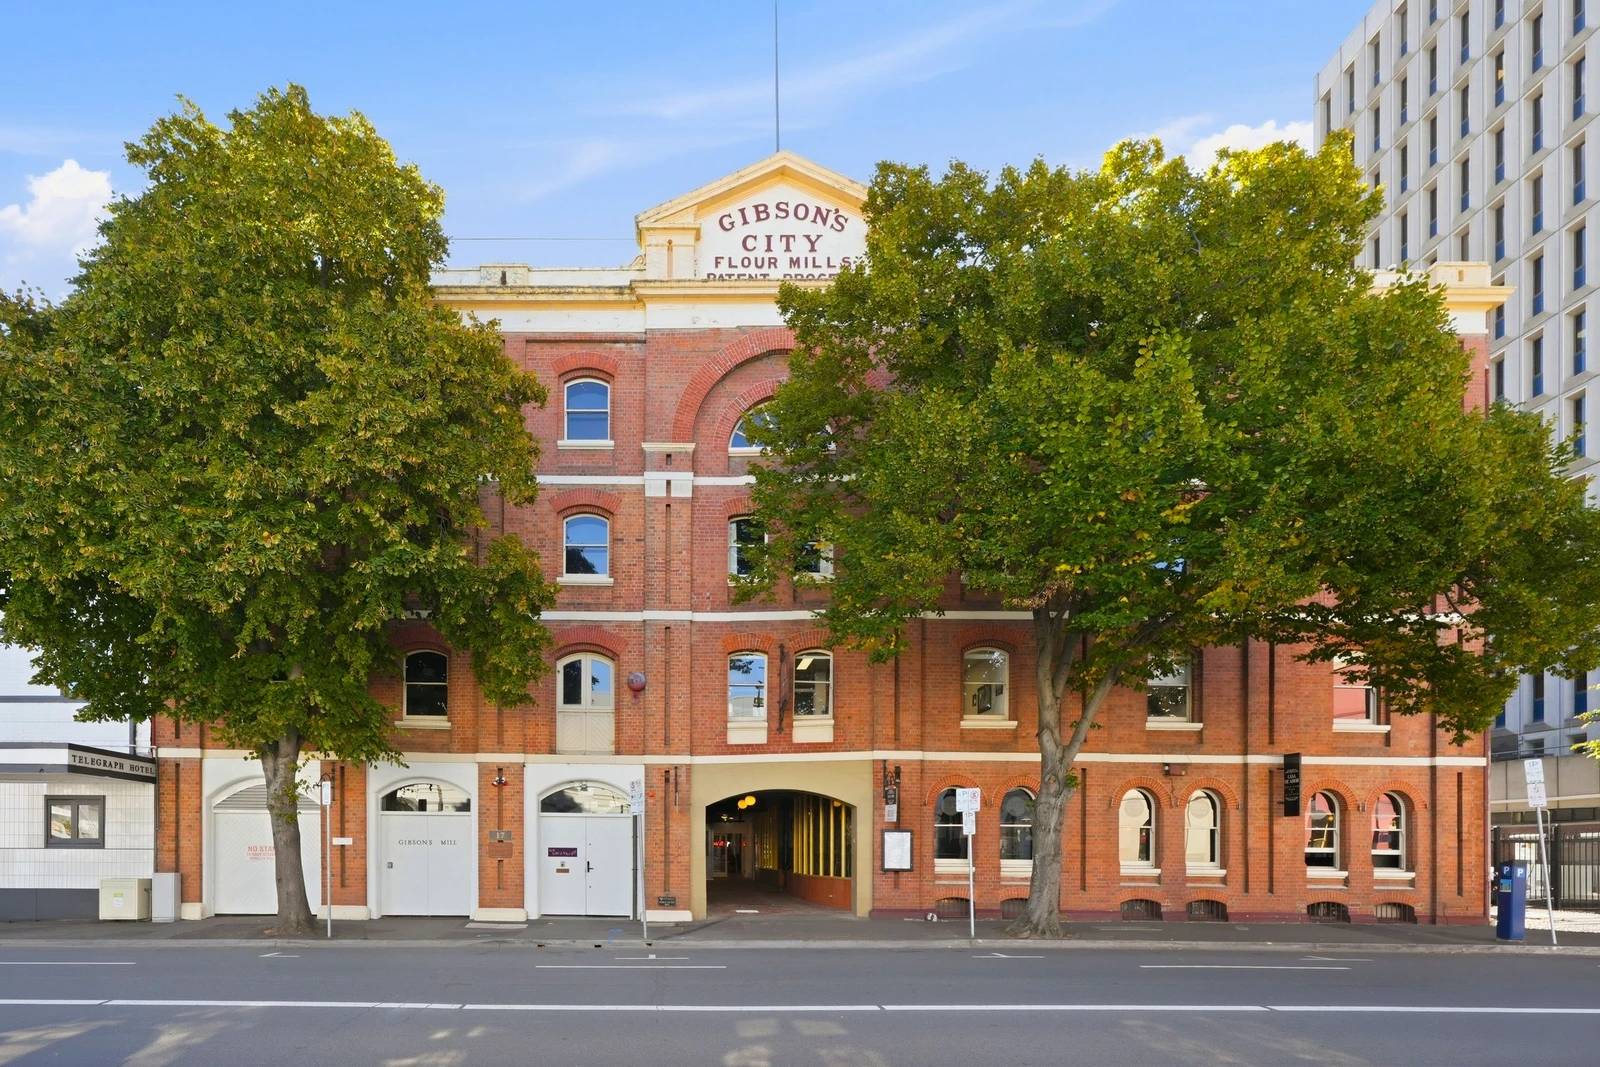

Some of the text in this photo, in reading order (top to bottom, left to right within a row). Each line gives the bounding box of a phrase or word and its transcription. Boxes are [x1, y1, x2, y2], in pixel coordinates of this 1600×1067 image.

[718, 201, 849, 232] GIBSON'S
[741, 234, 823, 253] CITY
[714, 256, 852, 269] FLOUR MILLS
[71, 754, 155, 775] TELEGRAPH HOTEL
[1517, 868, 1524, 877] P
